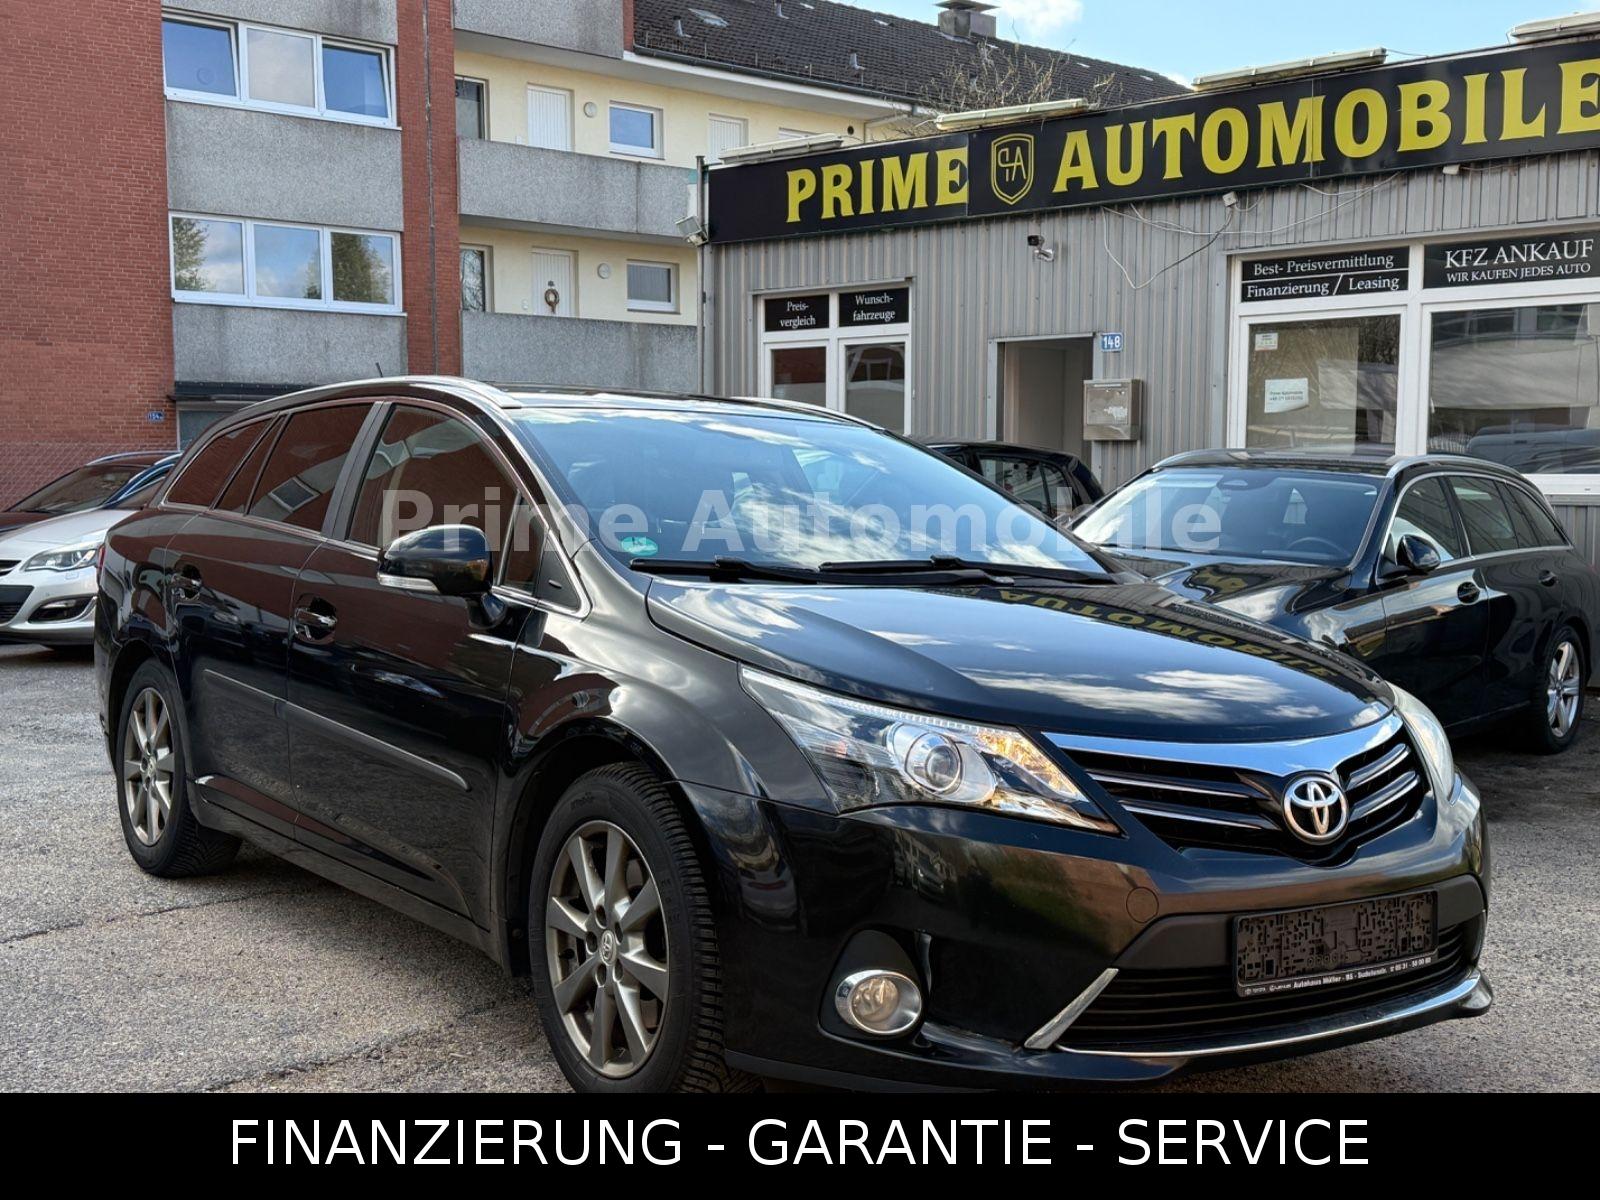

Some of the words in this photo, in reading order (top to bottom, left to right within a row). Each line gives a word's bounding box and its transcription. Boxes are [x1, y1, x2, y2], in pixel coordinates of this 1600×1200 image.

[1052, 58, 1600, 194] AUTOMOBILE
[786, 148, 969, 224] PRIME
[1254, 262, 1283, 276] Best-
[1286, 253, 1394, 274] Preisvermittlung
[1445, 247, 1489, 269] KFZ
[1493, 239, 1594, 265] ANKAUF
[1446, 272, 1469, 284] WIR
[1471, 268, 1518, 281] KAUFEN
[1520, 266, 1554, 279] JEDES
[1556, 262, 1591, 275] AUTO
[1246, 281, 1330, 298] Finanzierung
[1348, 276, 1400, 292] Leasing
[786, 300, 809, 313] Preis-
[855, 293, 894, 306] Wunsch-
[780, 315, 816, 329] vergleich
[852, 308, 896, 323] fahrzeuge
